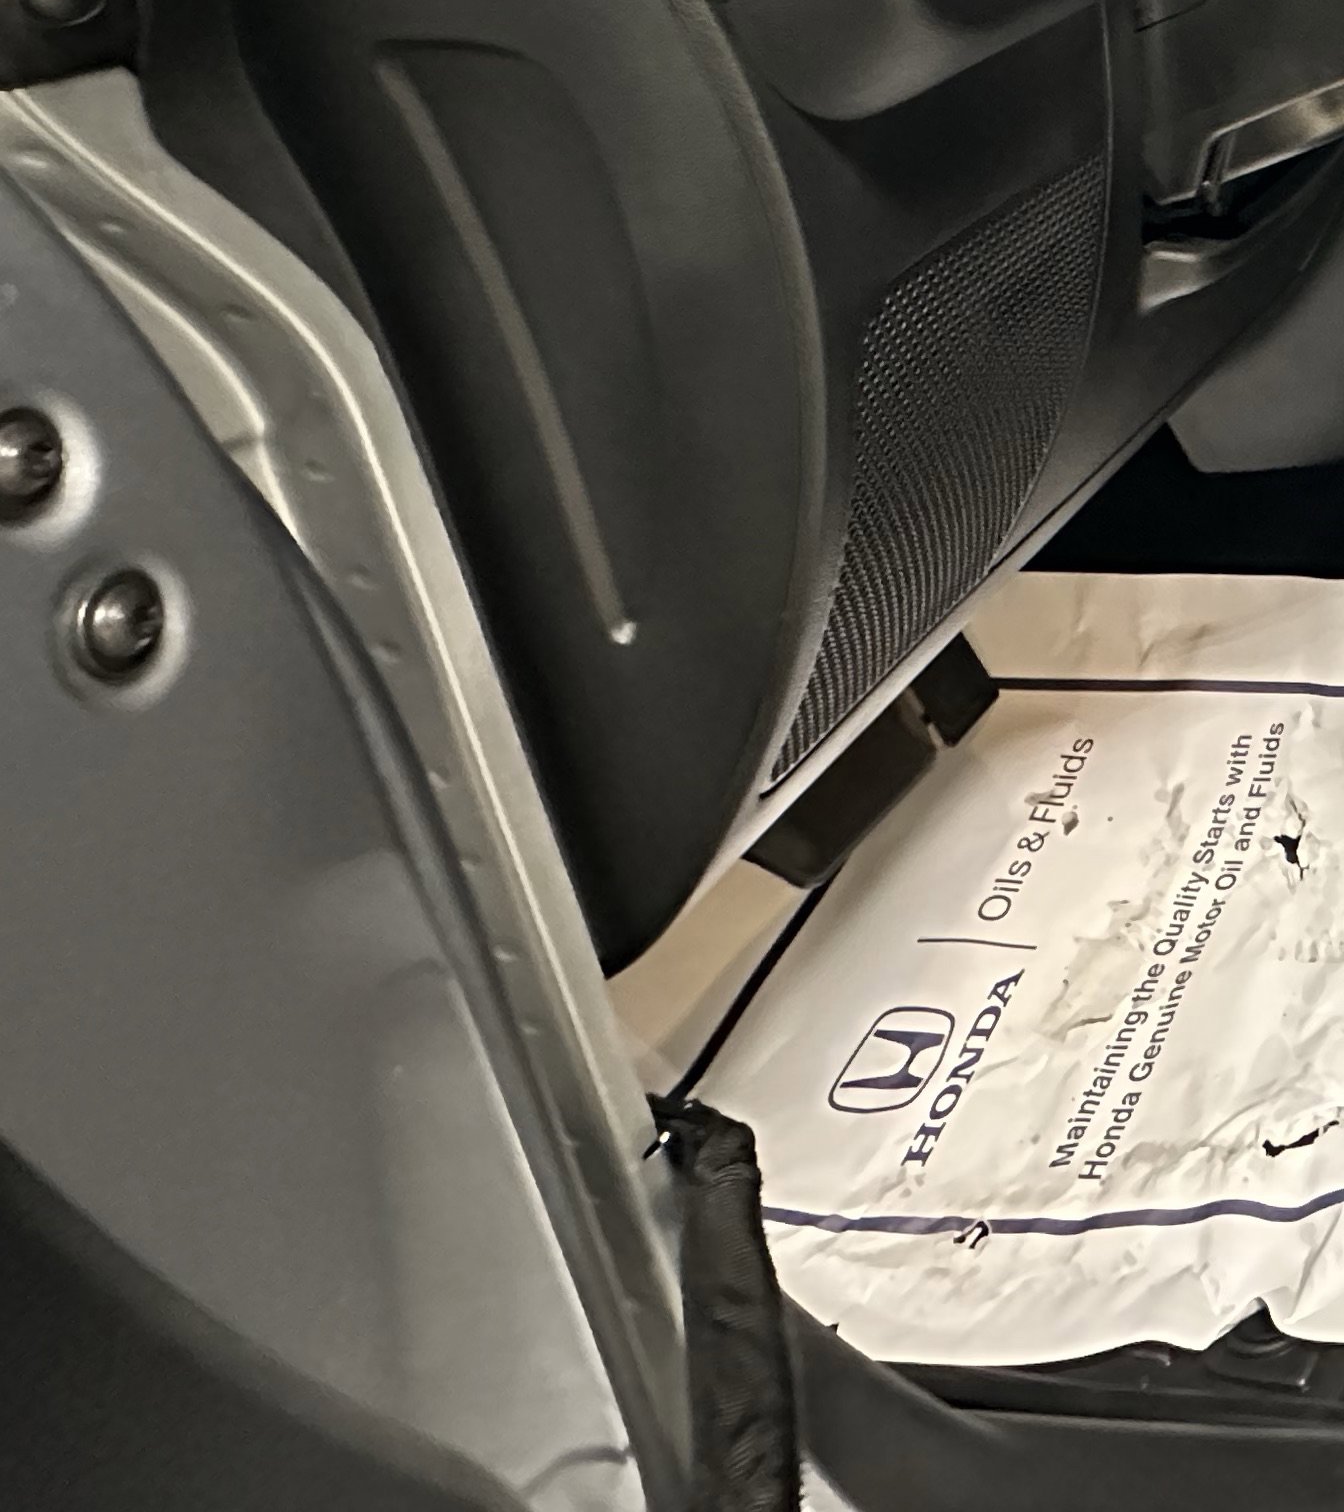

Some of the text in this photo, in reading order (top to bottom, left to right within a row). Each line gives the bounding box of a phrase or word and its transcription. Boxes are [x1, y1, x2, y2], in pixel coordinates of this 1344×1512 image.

[977, 738, 1095, 922] Oils & Fluids
[1048, 734, 1253, 1169] Maintaining the Quality Starts with
[1078, 722, 1285, 1180] Honda Genuine Motor Oil and Fluids
[900, 968, 1026, 1167] HONDA
